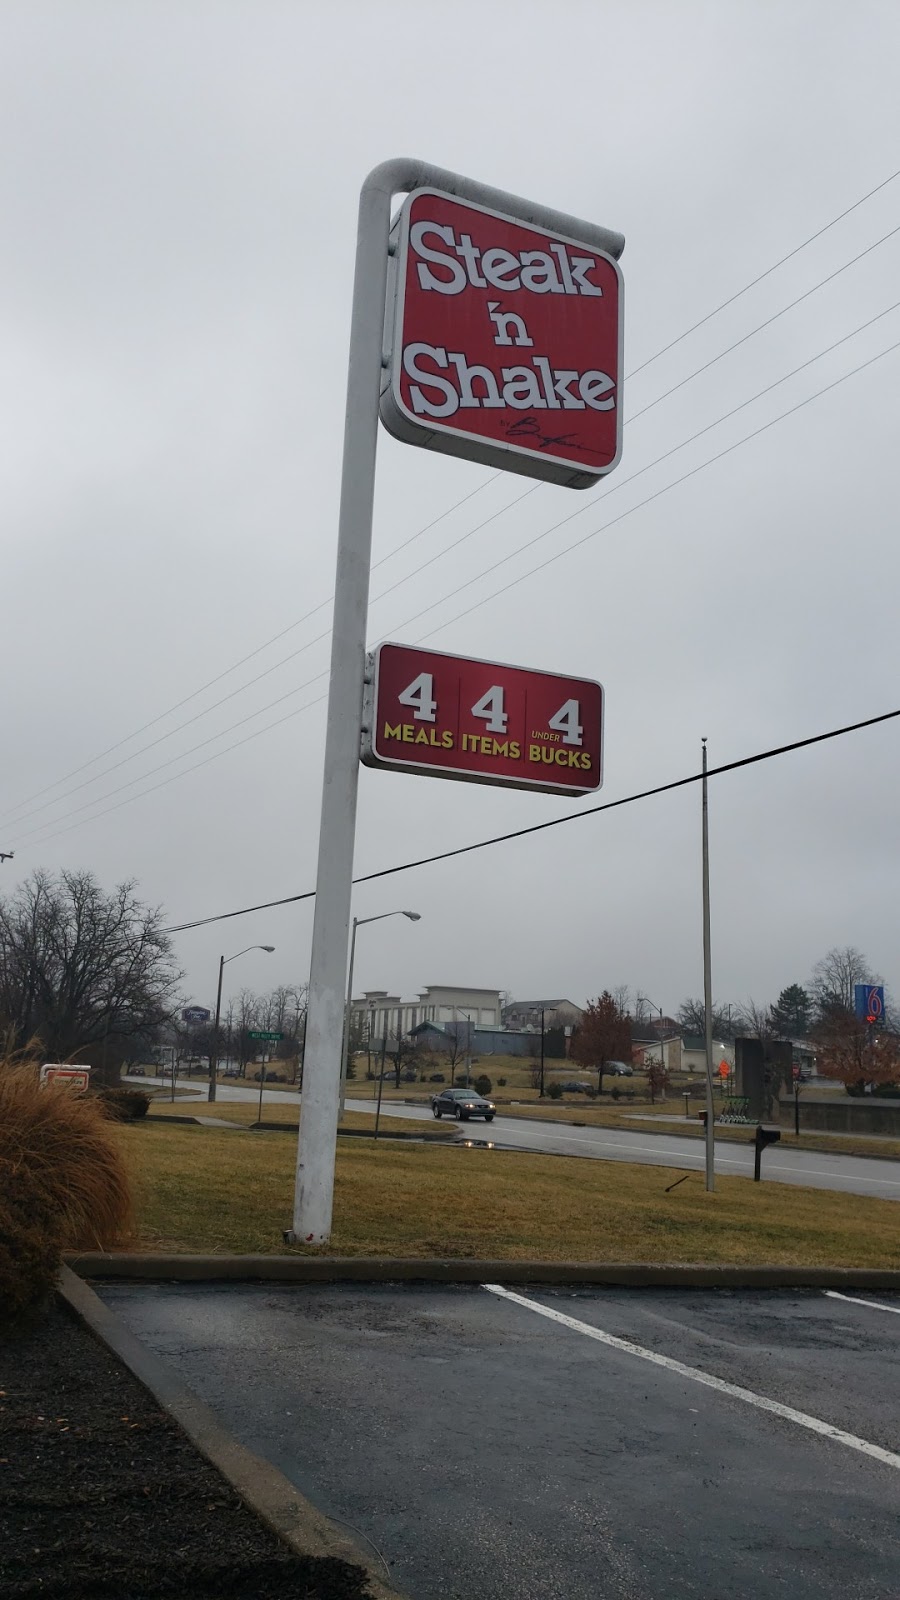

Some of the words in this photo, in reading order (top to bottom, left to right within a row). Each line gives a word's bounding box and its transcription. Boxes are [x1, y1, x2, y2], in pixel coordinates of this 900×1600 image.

[410, 221, 602, 297] Steak
[403, 342, 616, 418] Shake
[398, 672, 437, 723] 4
[471, 685, 508, 734] 4
[383, 721, 454, 749] MEALS
[462, 733, 521, 759] ITEMS
[532, 730, 560, 742] UNDER
[548, 698, 584, 746] 4
[529, 744, 592, 770] BUCKS
[868, 987, 882, 1016] 6
